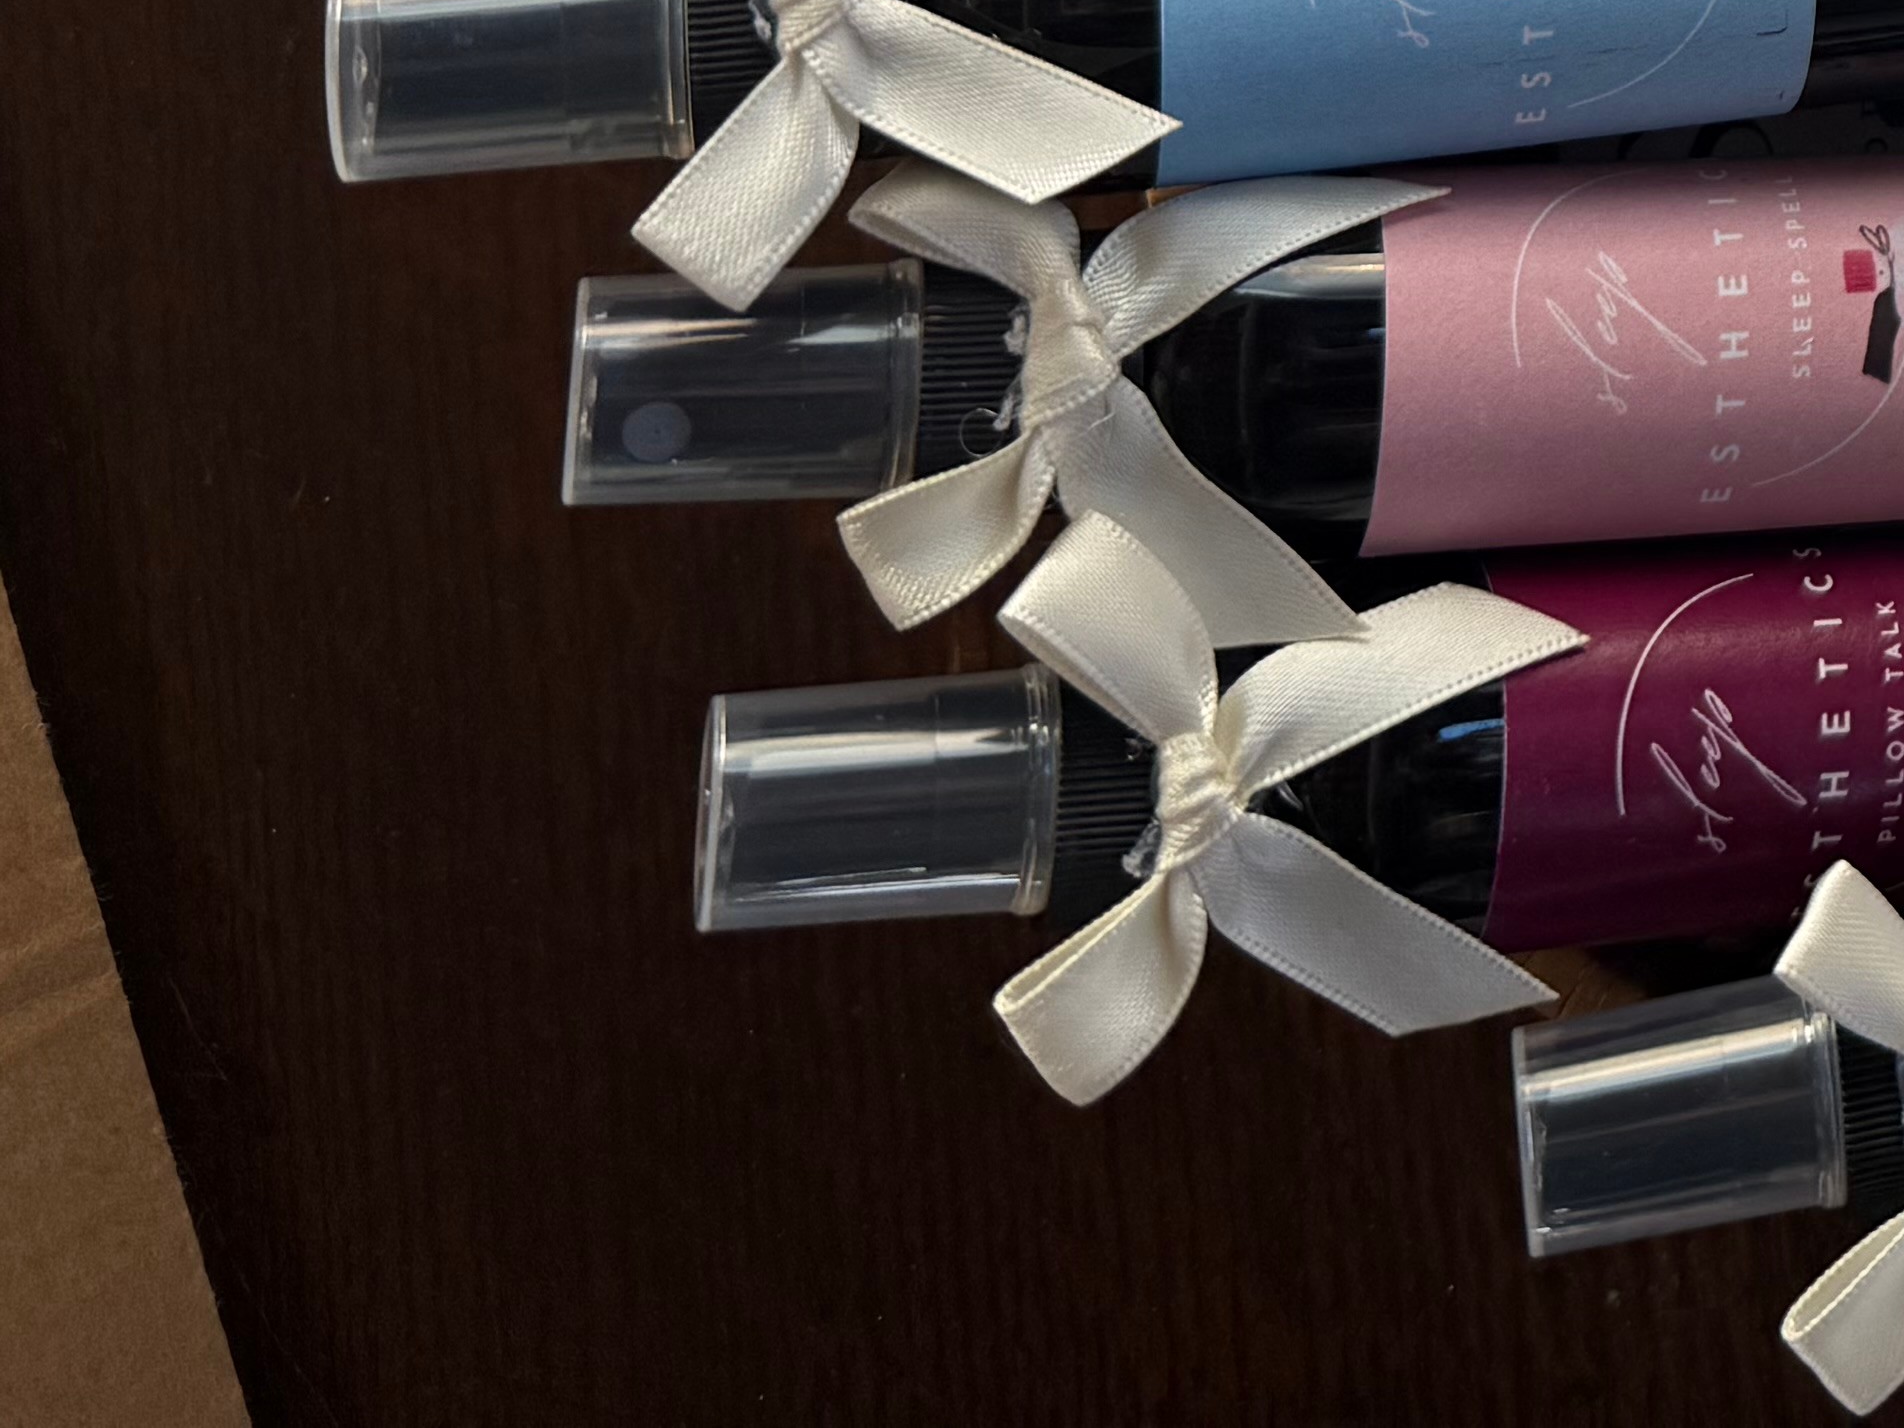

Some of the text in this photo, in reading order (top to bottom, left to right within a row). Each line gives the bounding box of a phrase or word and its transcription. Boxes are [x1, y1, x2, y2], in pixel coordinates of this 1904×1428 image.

[1546, 246, 1708, 415] sleep
[1699, 169, 1750, 502] ESTHETIC
[1775, 175, 1814, 379] SLEEP SPELL
[1875, 599, 1904, 682] TALK
[1650, 688, 1807, 854] sleep
[1790, 546, 1852, 922] THETICS
